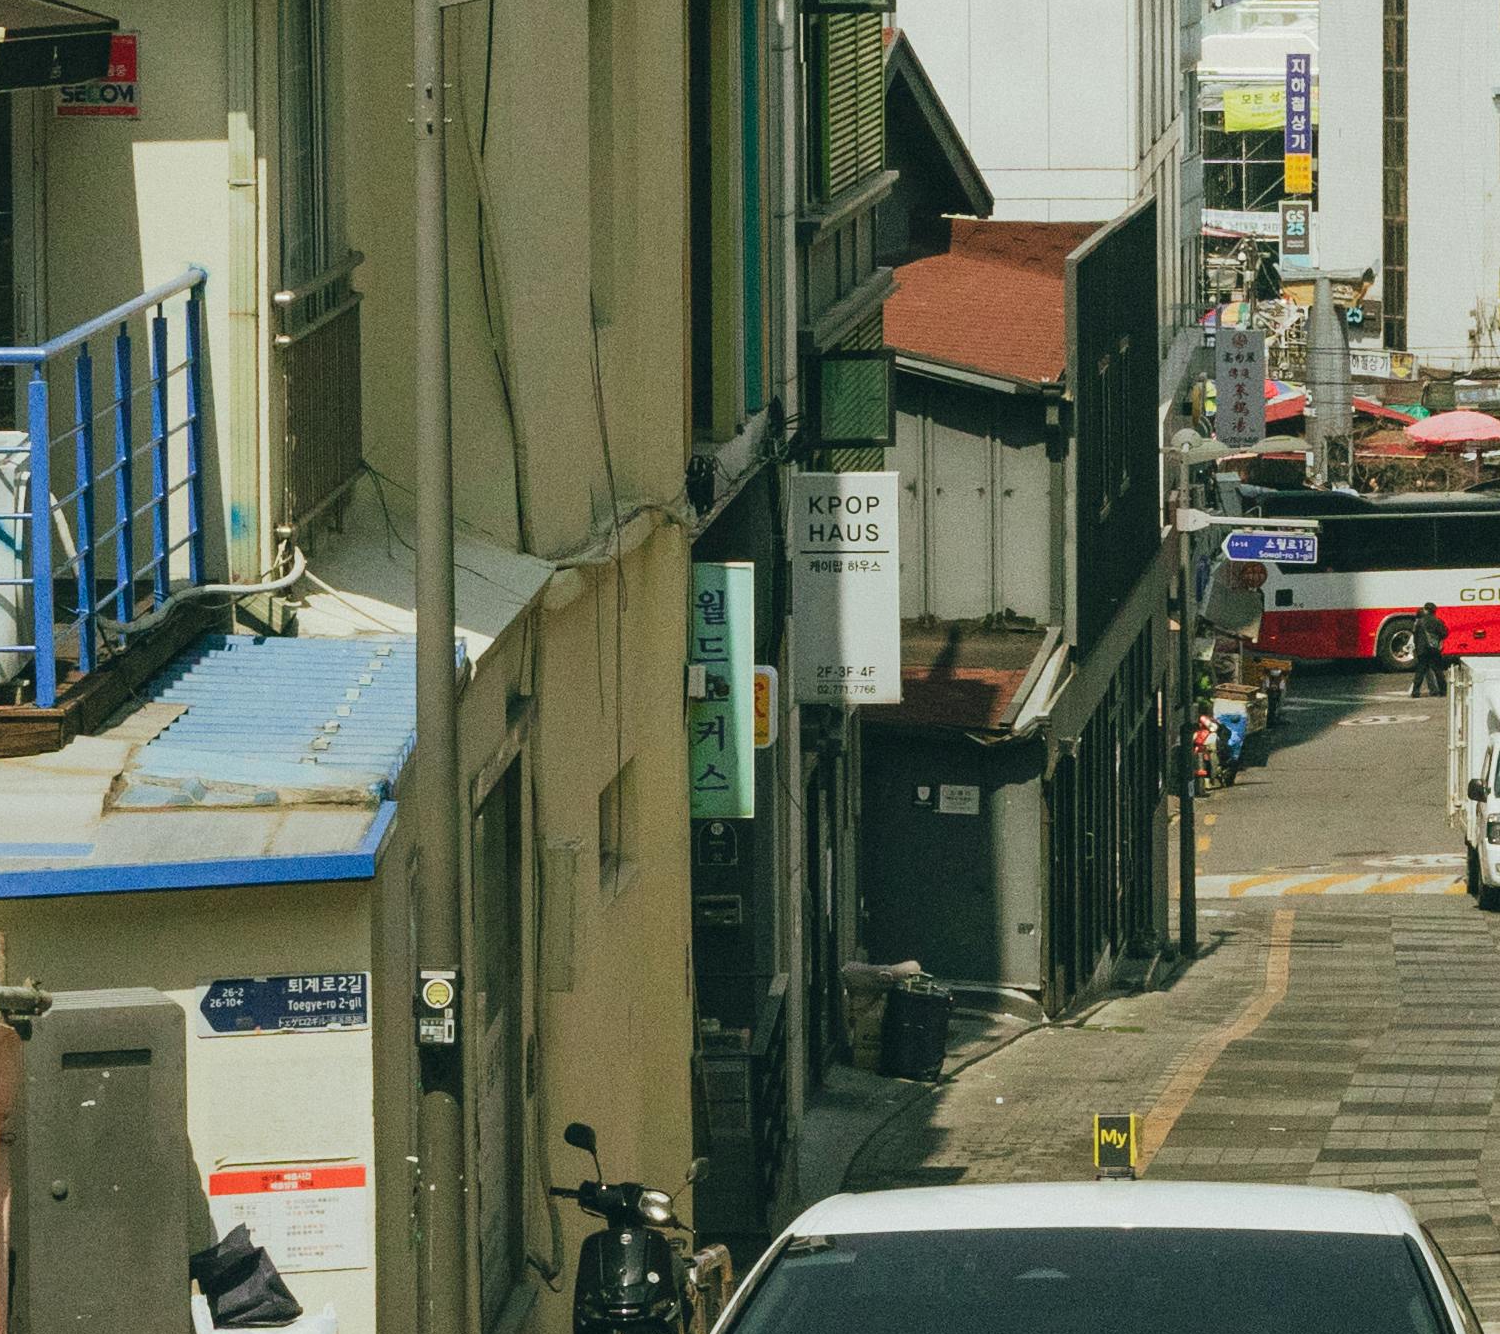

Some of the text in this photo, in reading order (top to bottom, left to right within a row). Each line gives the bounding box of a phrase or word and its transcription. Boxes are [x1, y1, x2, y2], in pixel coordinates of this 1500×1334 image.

[61, 83, 134, 104] SECOM
[1291, 58, 1306, 150] 지하철상가
[1286, 210, 1306, 222] GS
[1286, 222, 1305, 236] 25
[808, 496, 880, 515] KPOP
[809, 523, 879, 542] HAUS
[1264, 538, 1314, 552] 소월로1길
[848, 560, 882, 572] 하우스
[222, 987, 244, 997] 26-2
[288, 975, 363, 995] 퇴계로2길
[287, 997, 362, 1012] Toegye-ro 2-gil
[1101, 1129, 1127, 1148] My
